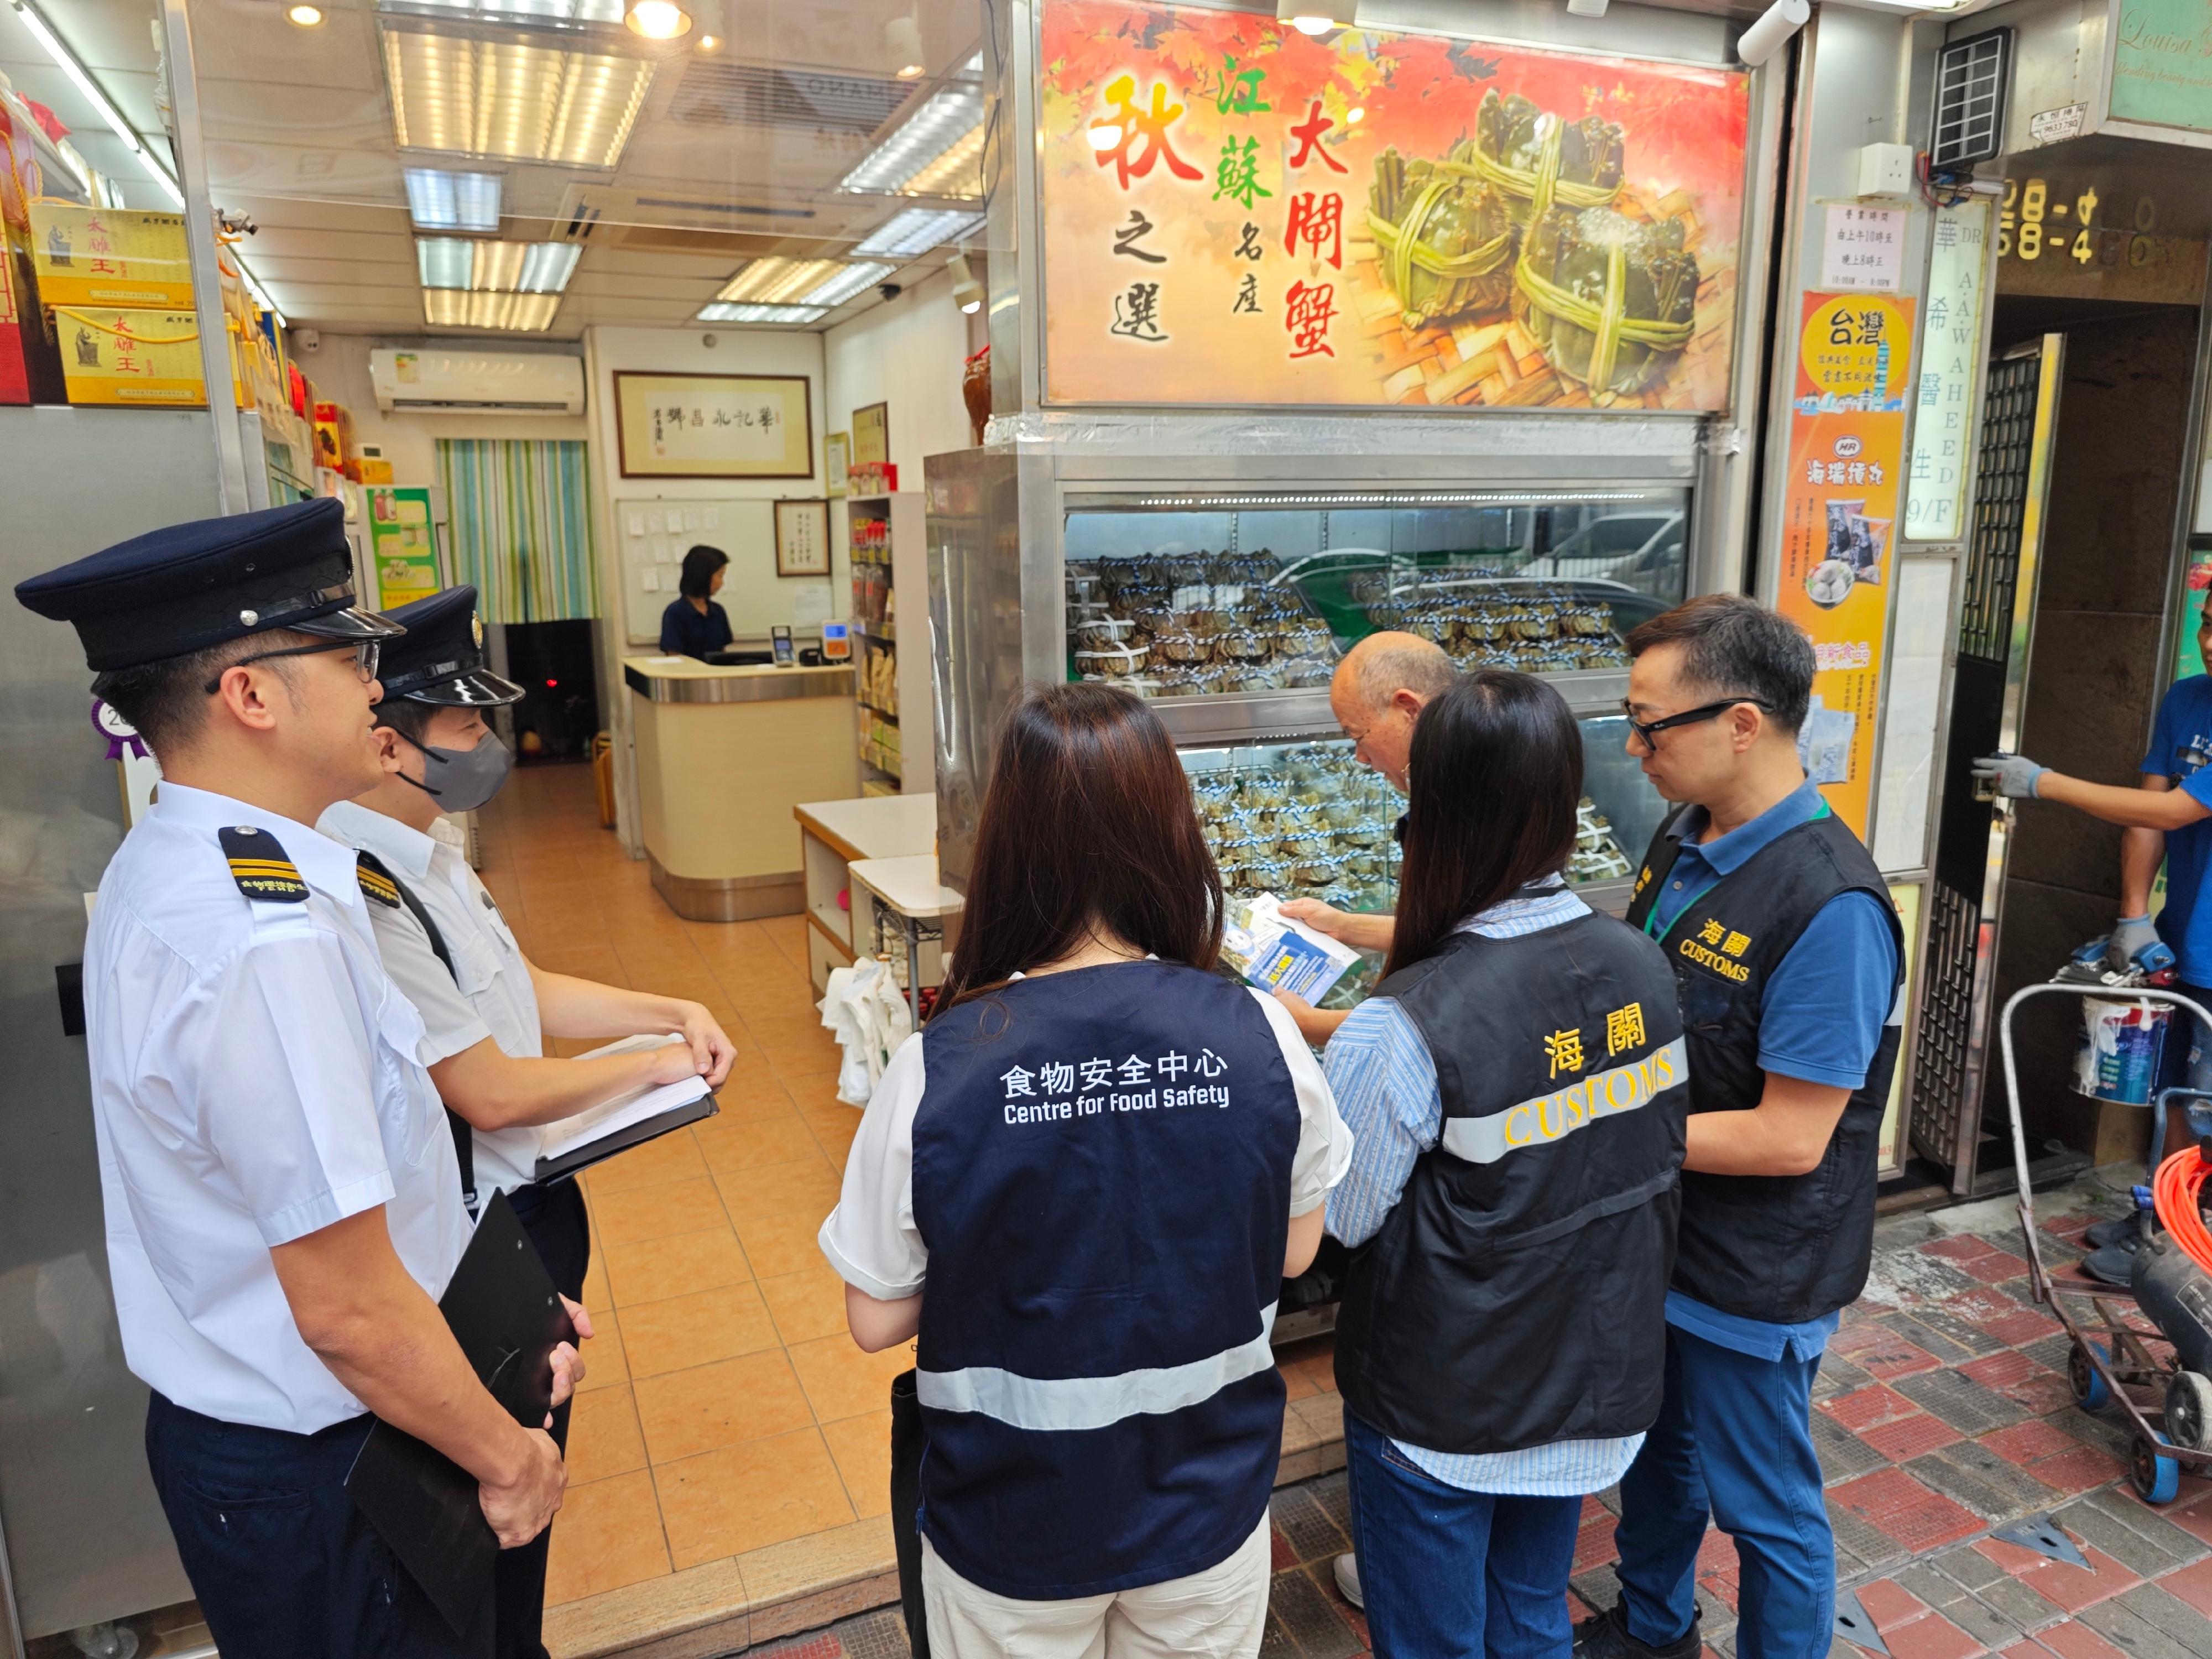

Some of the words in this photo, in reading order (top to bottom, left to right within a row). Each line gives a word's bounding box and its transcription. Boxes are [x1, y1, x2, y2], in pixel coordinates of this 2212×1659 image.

[2117, 8, 2193, 53] Louisa
[1086, 74, 1204, 342] 秋之選
[1284, 100, 1348, 359] 大閘蟹
[1961, 227, 1981, 244] DR
[1830, 308, 1884, 347] 台灣
[1906, 498, 1953, 523] 9/F
[1696, 917, 1752, 957] 海關
[1679, 938, 1751, 982] CUSTOMS
[1543, 1002, 1647, 1080] 海關
[999, 1048, 1228, 1099] 食物安全中心
[1004, 1099, 1072, 1124] Centre
[1076, 1094, 1105, 1117] for
[1110, 1088, 1157, 1112] Food
[1163, 1084, 1230, 1108] Safety
[1504, 1047, 1675, 1146] CUSTOMS
